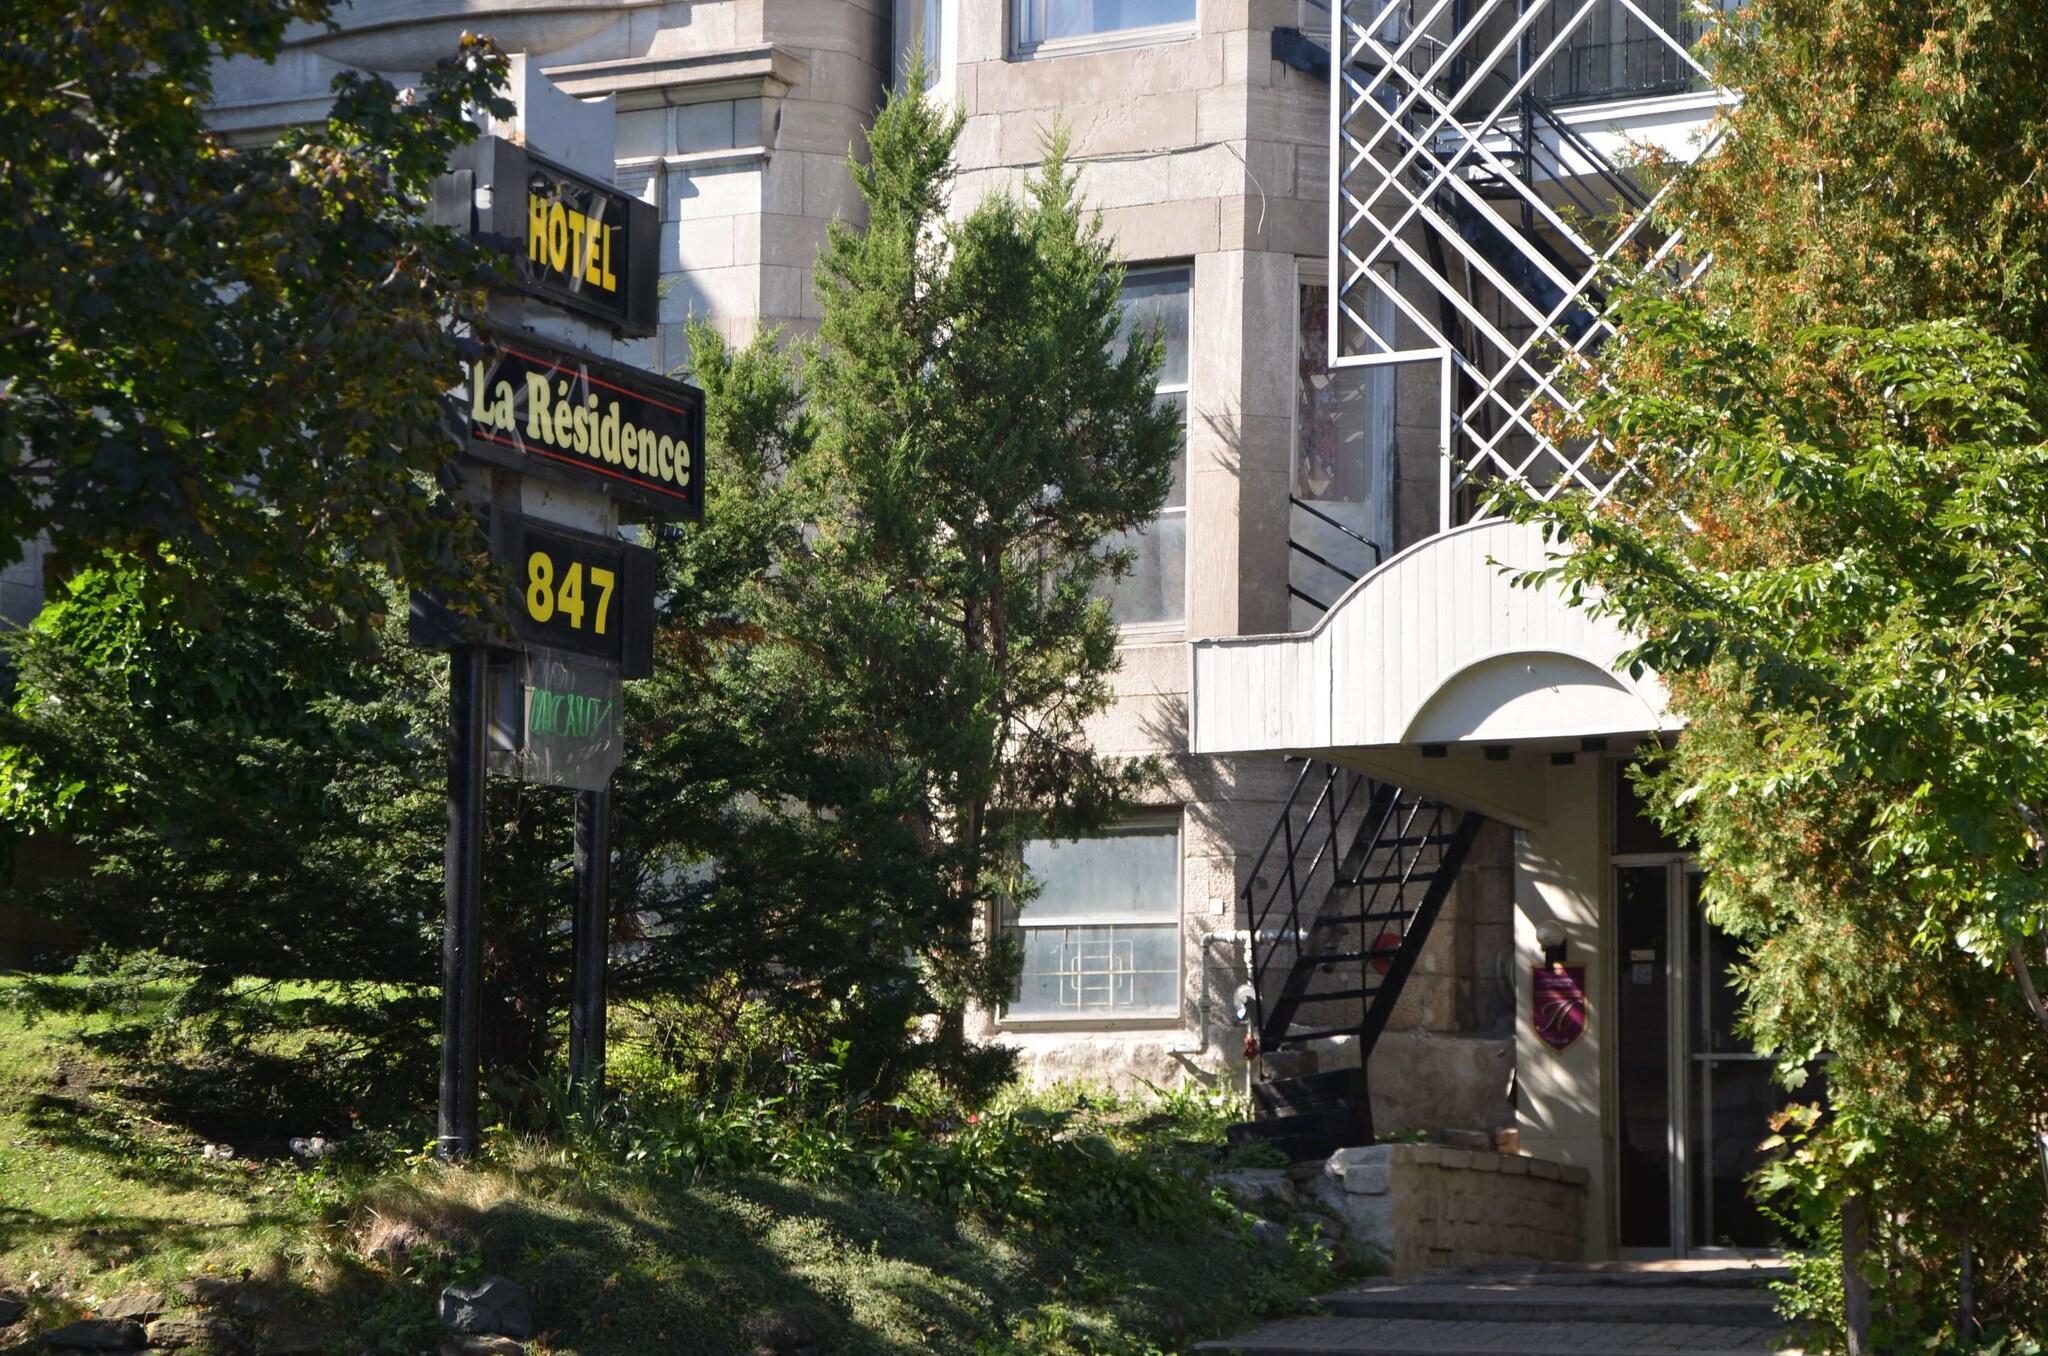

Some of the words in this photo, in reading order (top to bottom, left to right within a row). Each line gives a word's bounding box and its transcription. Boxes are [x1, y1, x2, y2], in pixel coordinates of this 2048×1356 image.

[529, 192, 616, 292] HOTEL
[472, 360, 516, 432] La
[526, 371, 690, 486] Résidence
[526, 551, 615, 634] 847
